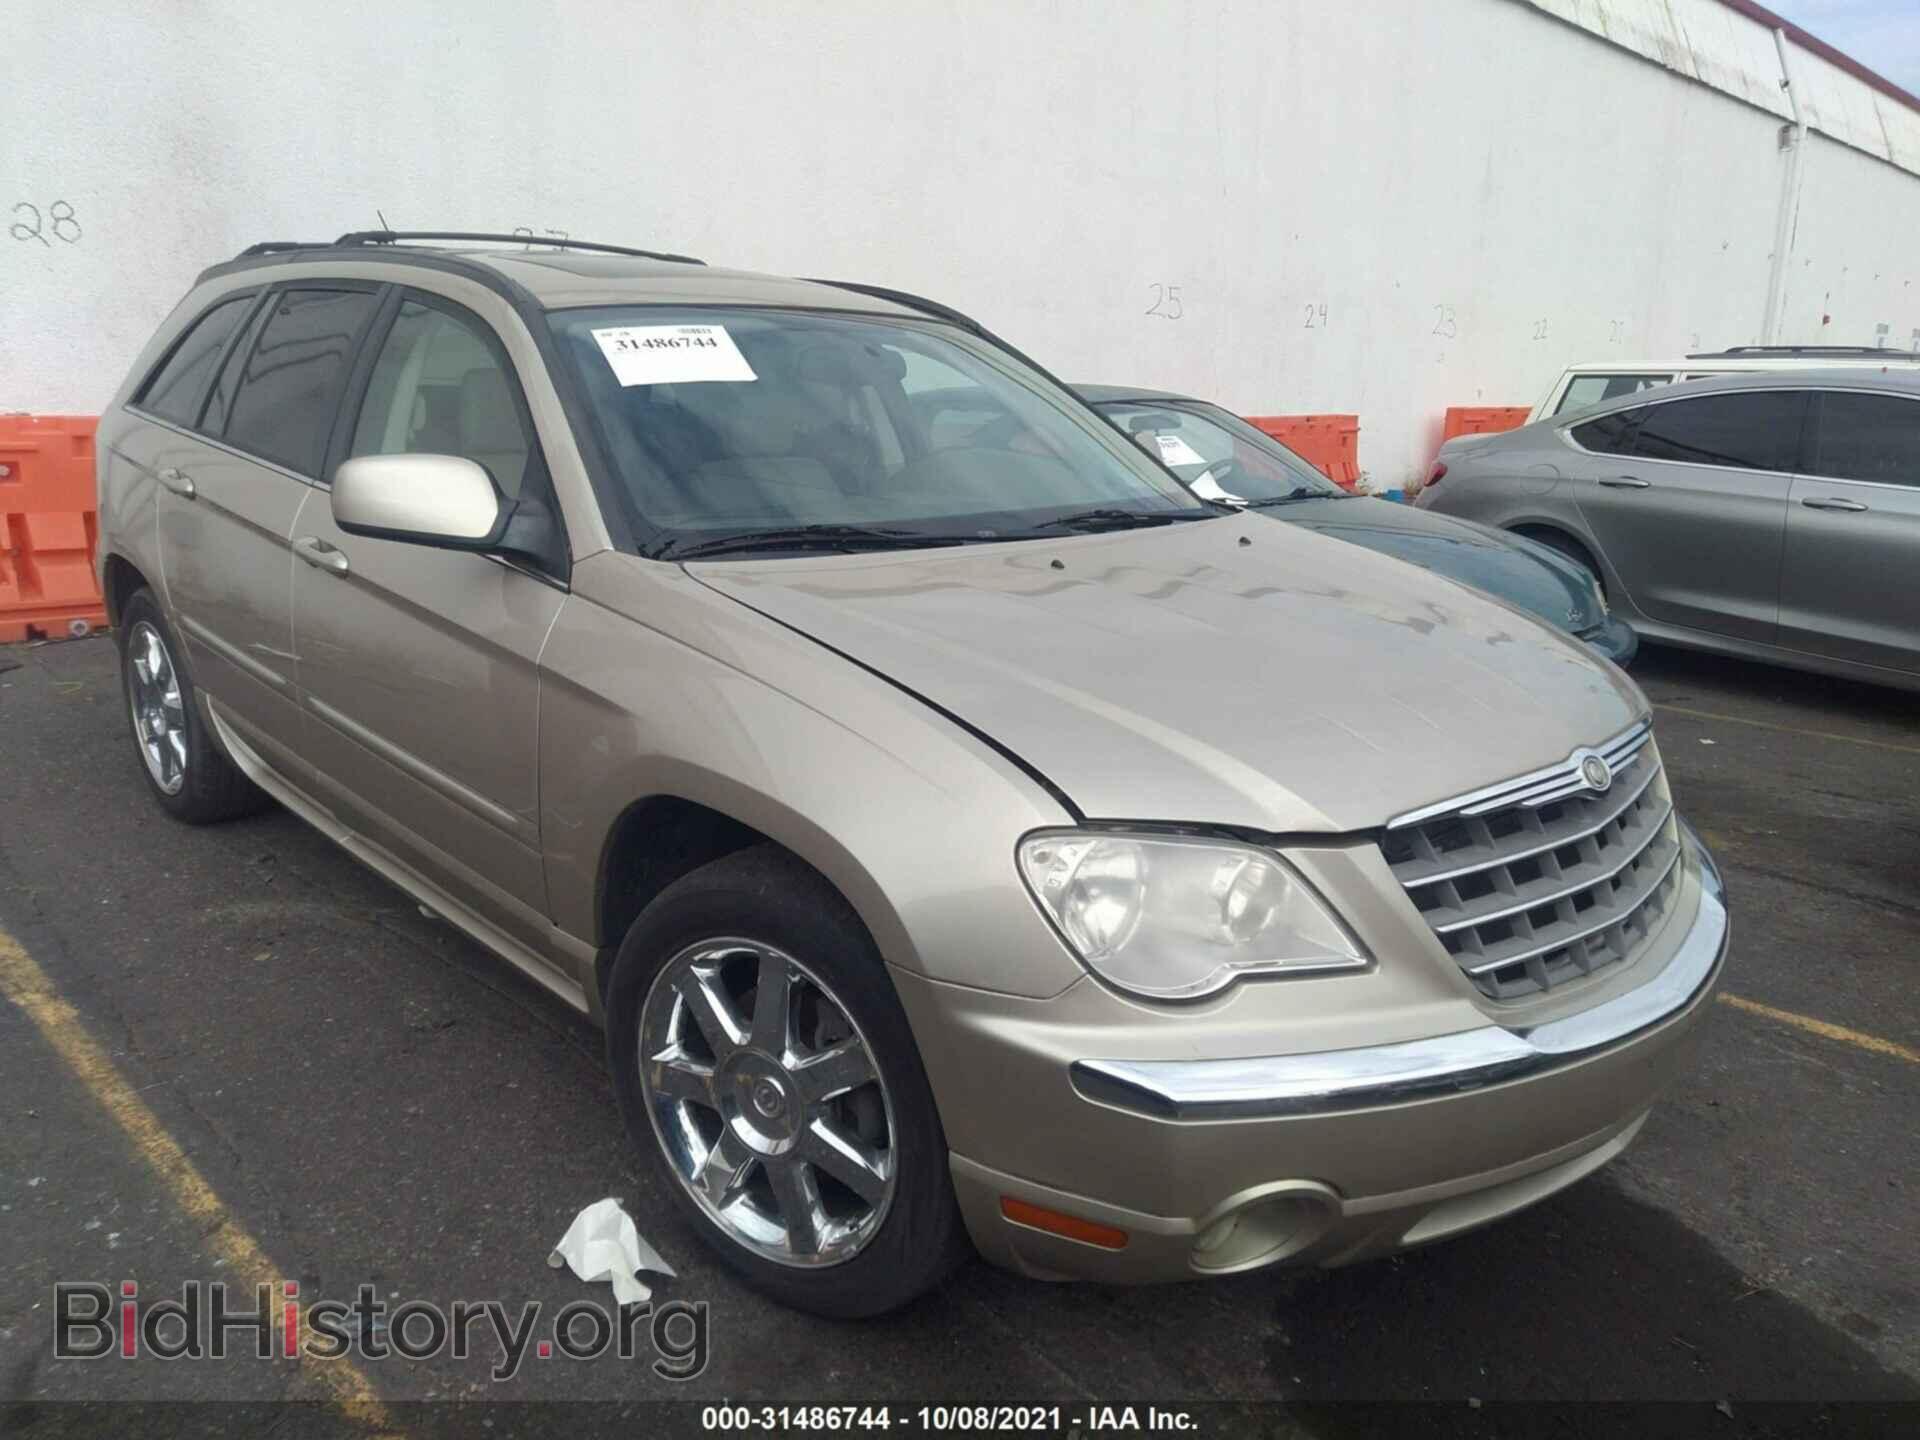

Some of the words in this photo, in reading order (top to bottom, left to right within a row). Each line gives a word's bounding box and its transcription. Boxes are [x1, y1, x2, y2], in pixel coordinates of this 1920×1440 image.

[9, 199, 83, 248] 28
[1144, 282, 1184, 320] 25
[1303, 303, 1328, 329] 24
[1432, 303, 1457, 339] 23
[614, 336, 719, 352] 31486744
